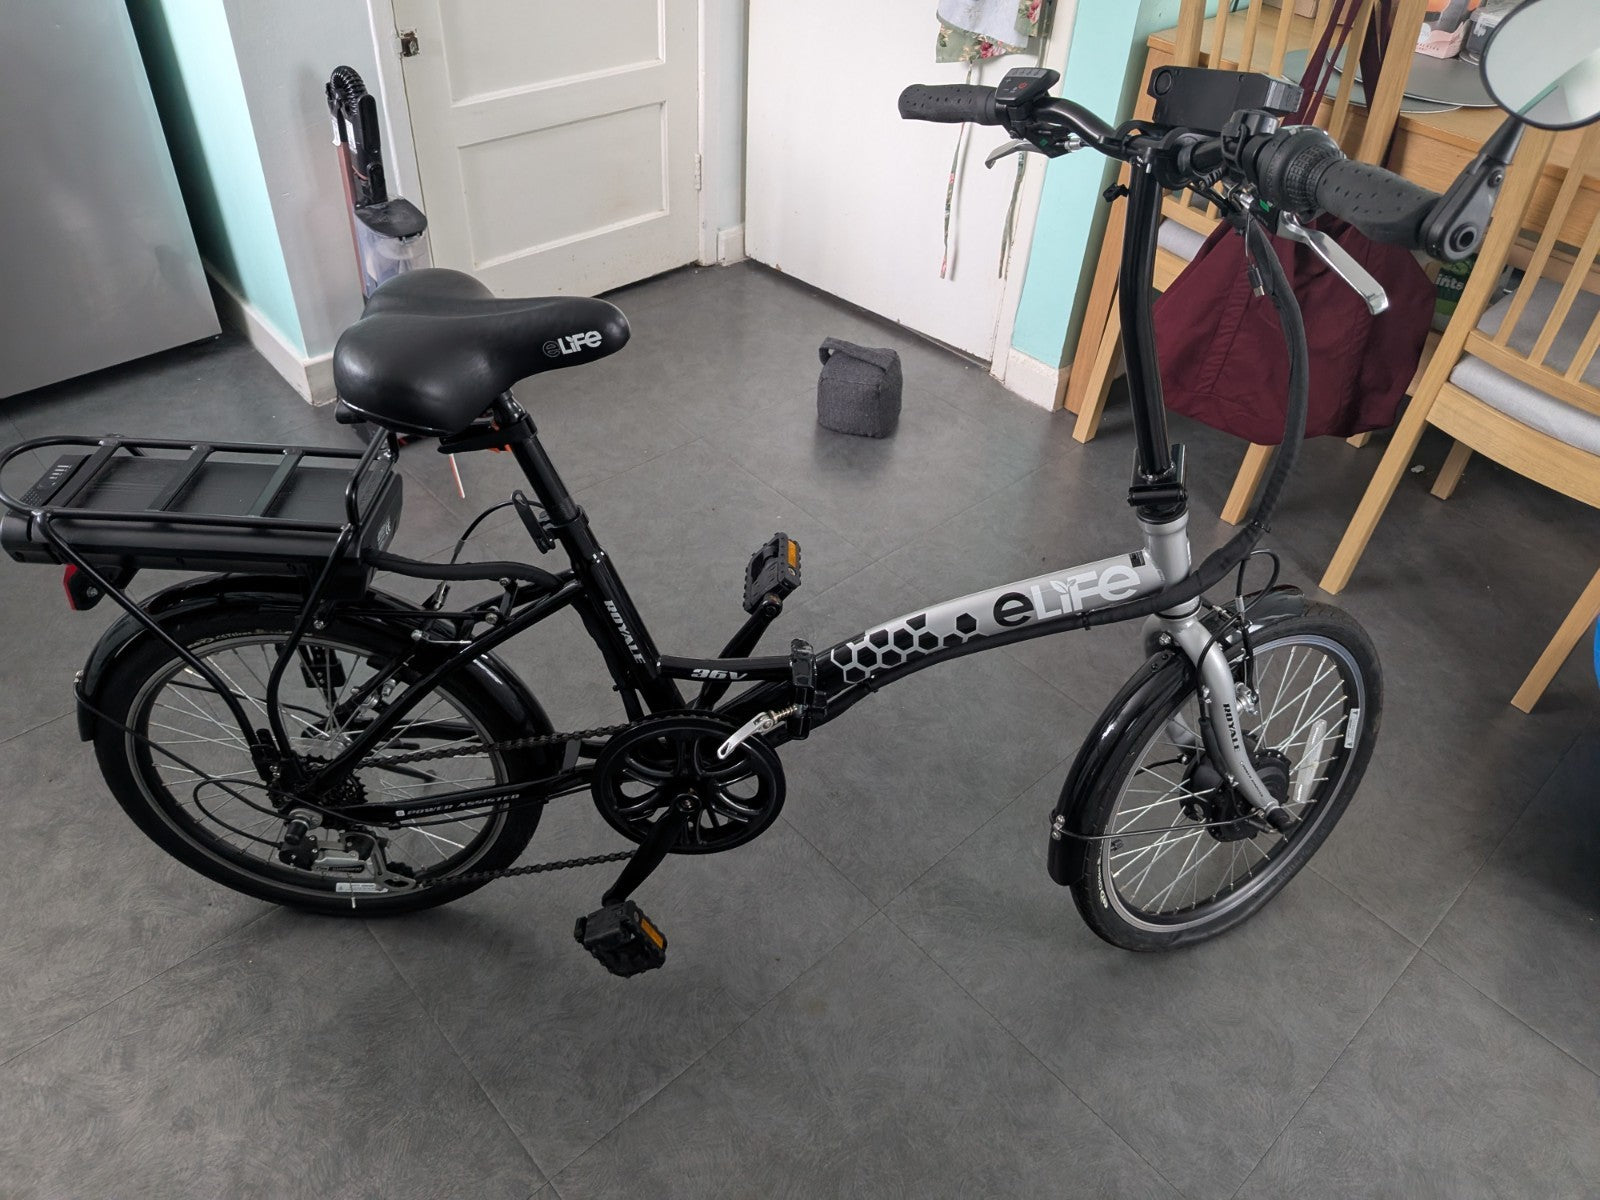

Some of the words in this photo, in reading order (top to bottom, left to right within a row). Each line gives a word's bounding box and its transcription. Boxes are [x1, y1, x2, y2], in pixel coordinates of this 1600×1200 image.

[604, 600, 647, 664] ROYALE
[690, 668, 748, 680] 36V
[1222, 703, 1241, 752] ROYALE
[407, 804, 454, 816] POWER
[456, 794, 520, 809] ASSISTED
